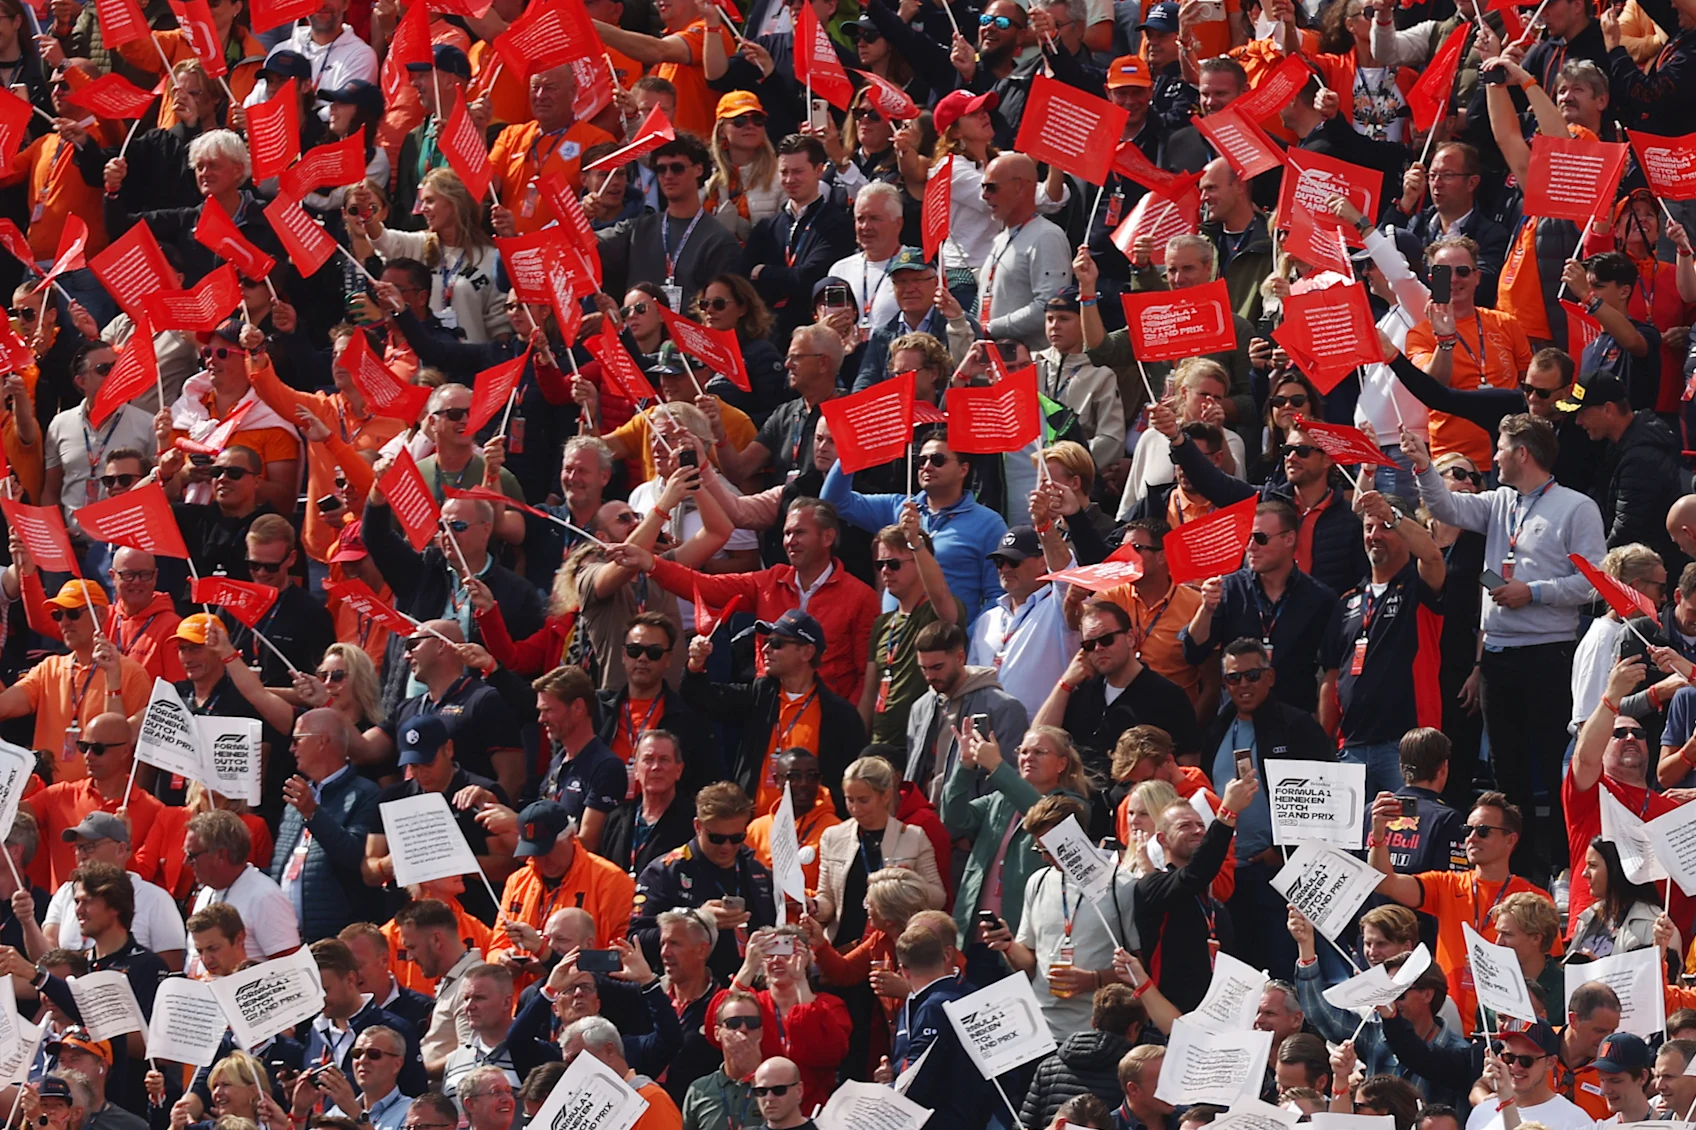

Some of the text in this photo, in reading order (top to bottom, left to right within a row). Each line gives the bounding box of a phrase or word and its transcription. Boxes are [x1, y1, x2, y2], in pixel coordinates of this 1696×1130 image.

[1645, 159, 1691, 170] HEINEKEN
[1140, 309, 1190, 321] FORMULA
[1141, 314, 1191, 327] HEINEKEN
[1143, 323, 1177, 334] DUTCH
[1144, 324, 1205, 341] GRAND PRIX
[144, 719, 177, 736] DUTCH
[1275, 788, 1325, 797] FORMULA
[1275, 795, 1325, 804] HEINEKEN
[1311, 812, 1335, 821] PRIX
[1293, 870, 1322, 904] ORMULA
[1298, 874, 1329, 910] EINEKEN
[1330, 873, 1349, 894] PRIX
[234, 980, 283, 1004] FORMULA
[238, 985, 287, 1010] HEINEKEN
[242, 996, 275, 1016] DUTCH
[245, 991, 304, 1022] GRAND PRIX
[996, 1029, 1020, 1044] PRIX
[595, 1102, 614, 1125] PRIX
